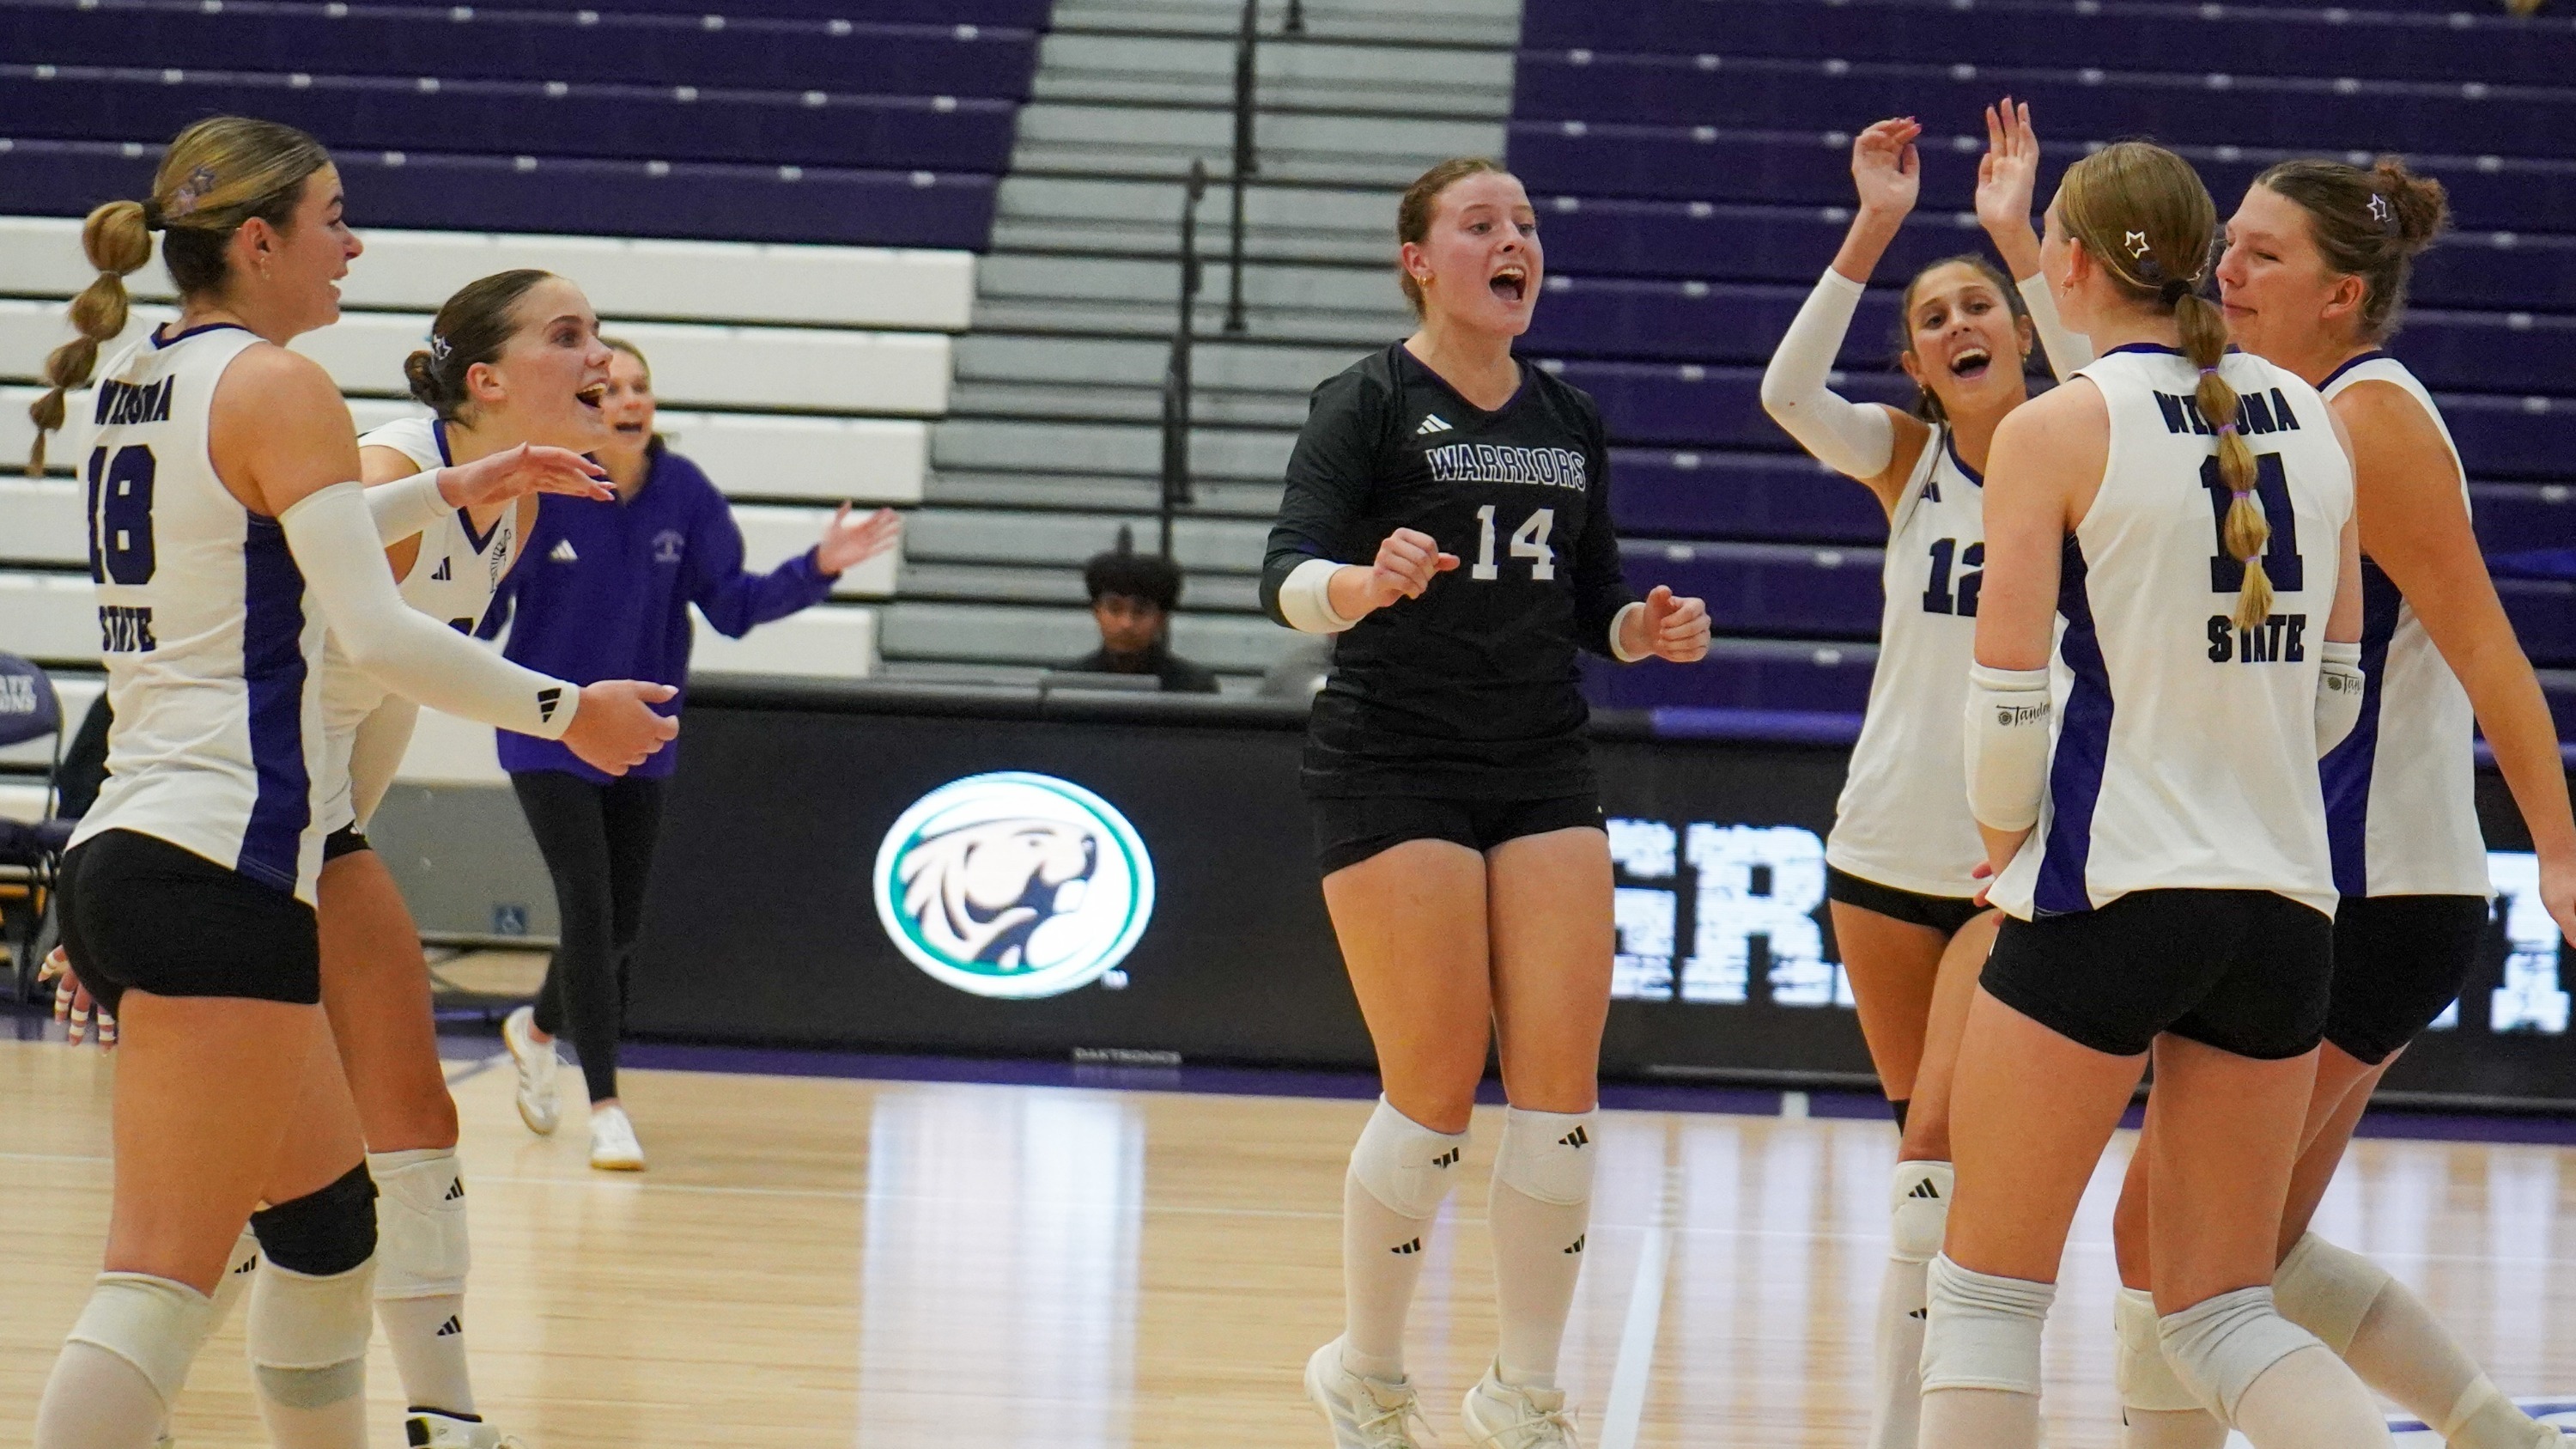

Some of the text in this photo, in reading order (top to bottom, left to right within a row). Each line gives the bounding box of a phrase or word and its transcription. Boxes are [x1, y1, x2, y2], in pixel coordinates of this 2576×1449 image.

[2153, 387, 2300, 435] WIONA
[1425, 443, 1586, 492] WARRIORS
[88, 443, 156, 585] 18
[1472, 504, 1555, 581] 14
